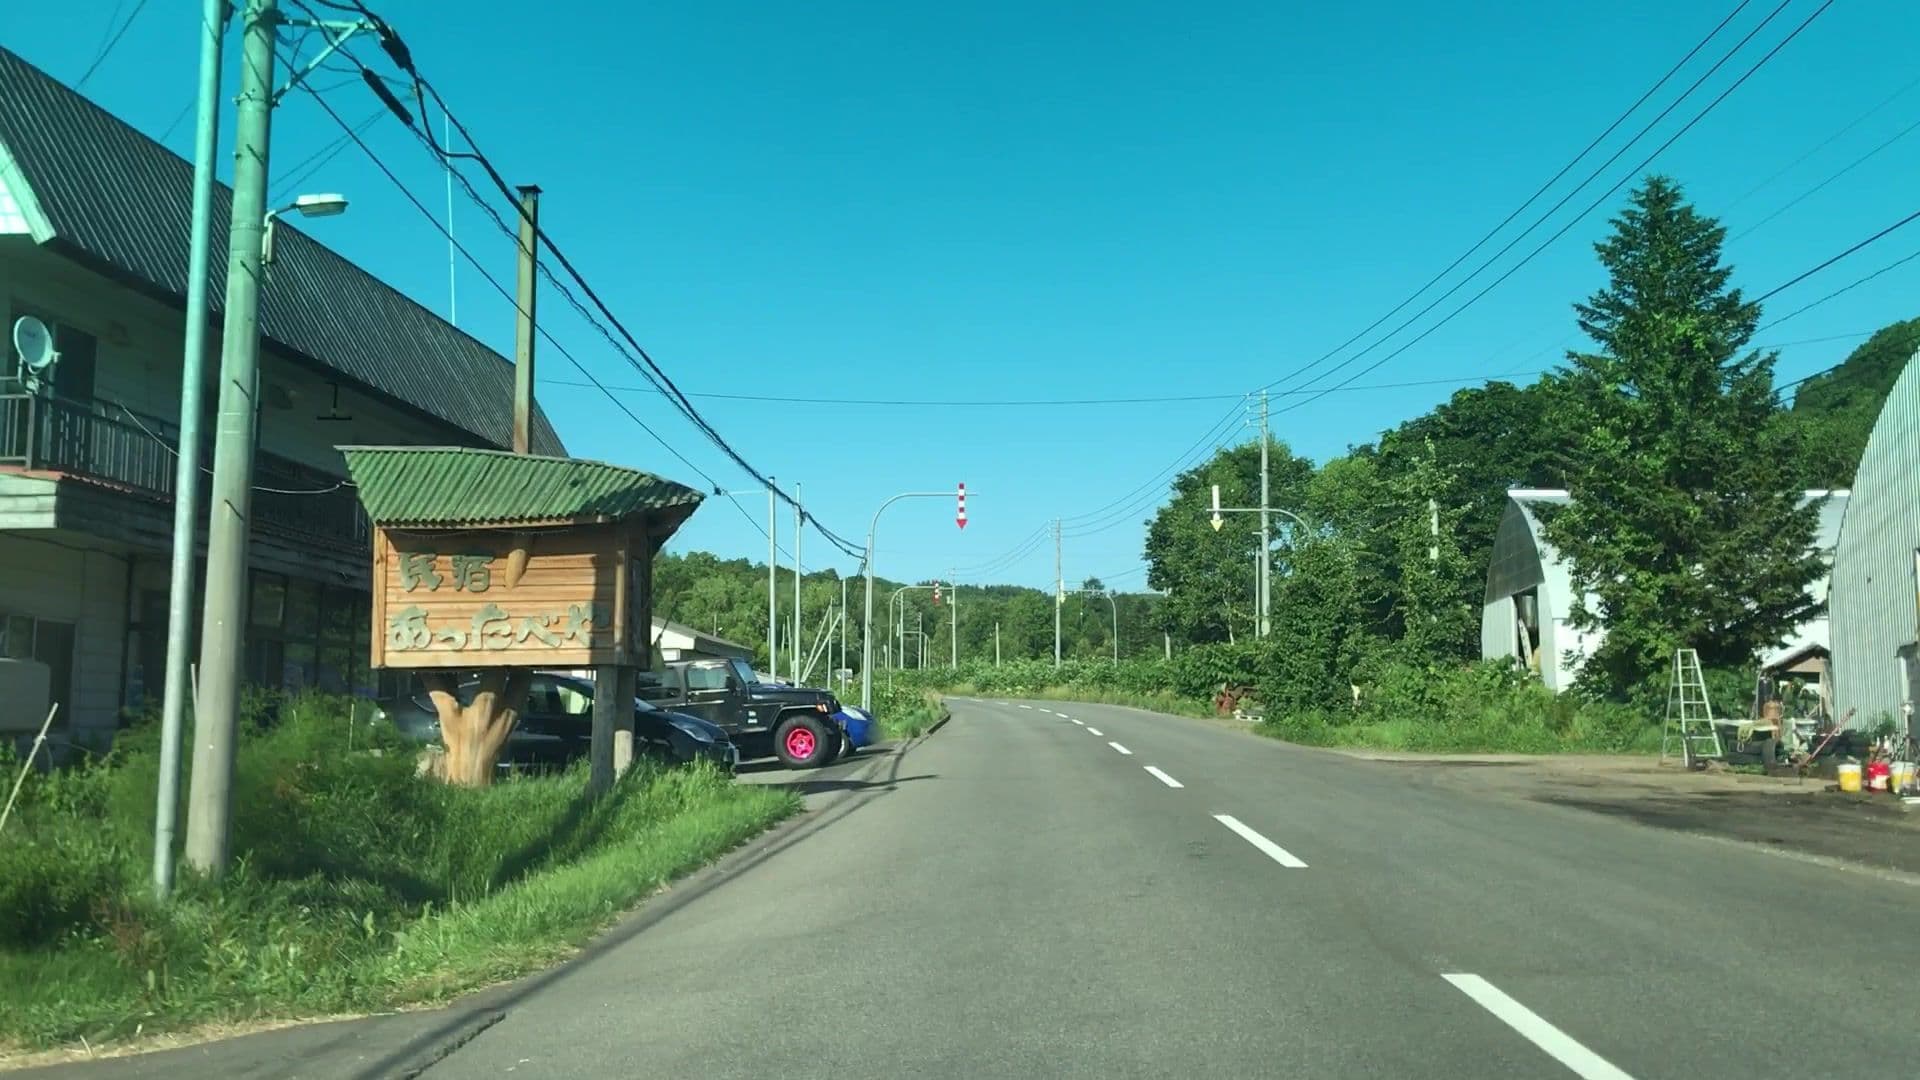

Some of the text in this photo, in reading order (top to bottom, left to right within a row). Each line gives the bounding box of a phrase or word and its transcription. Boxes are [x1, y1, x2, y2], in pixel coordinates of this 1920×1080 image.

[399, 547, 494, 592] 民宿
[390, 601, 609, 651] あったべや
